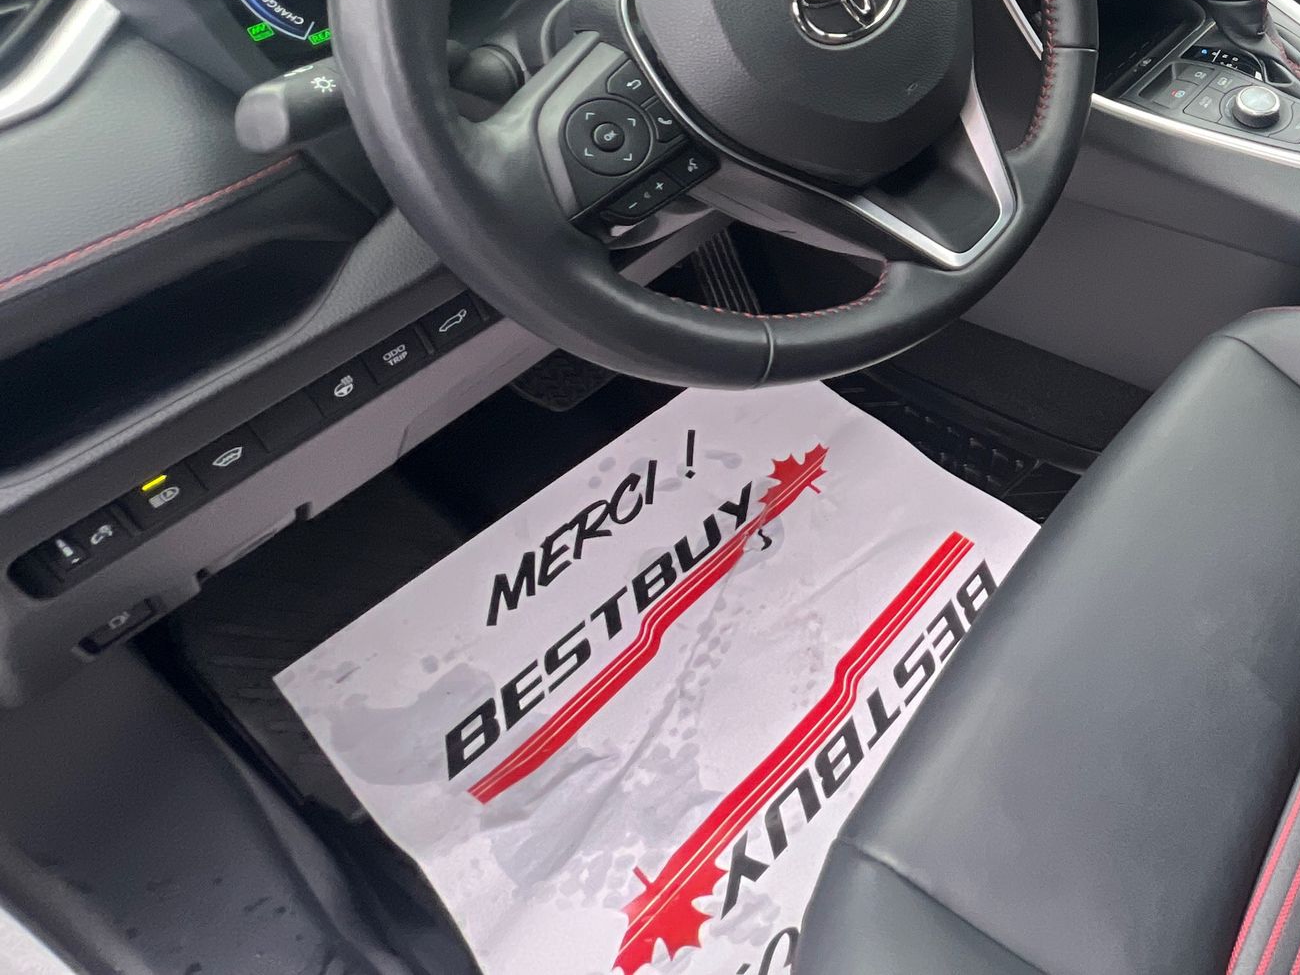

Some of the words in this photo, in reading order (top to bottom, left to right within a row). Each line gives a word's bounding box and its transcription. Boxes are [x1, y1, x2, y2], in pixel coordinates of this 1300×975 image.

[310, 29, 332, 44] REA
[603, 129, 619, 142] OK
[382, 344, 406, 361] ODO
[387, 350, 408, 366] TRIP
[486, 459, 658, 627] MERCI
[445, 480, 753, 781] BESTBUY
[718, 557, 999, 921] BESTBUY
